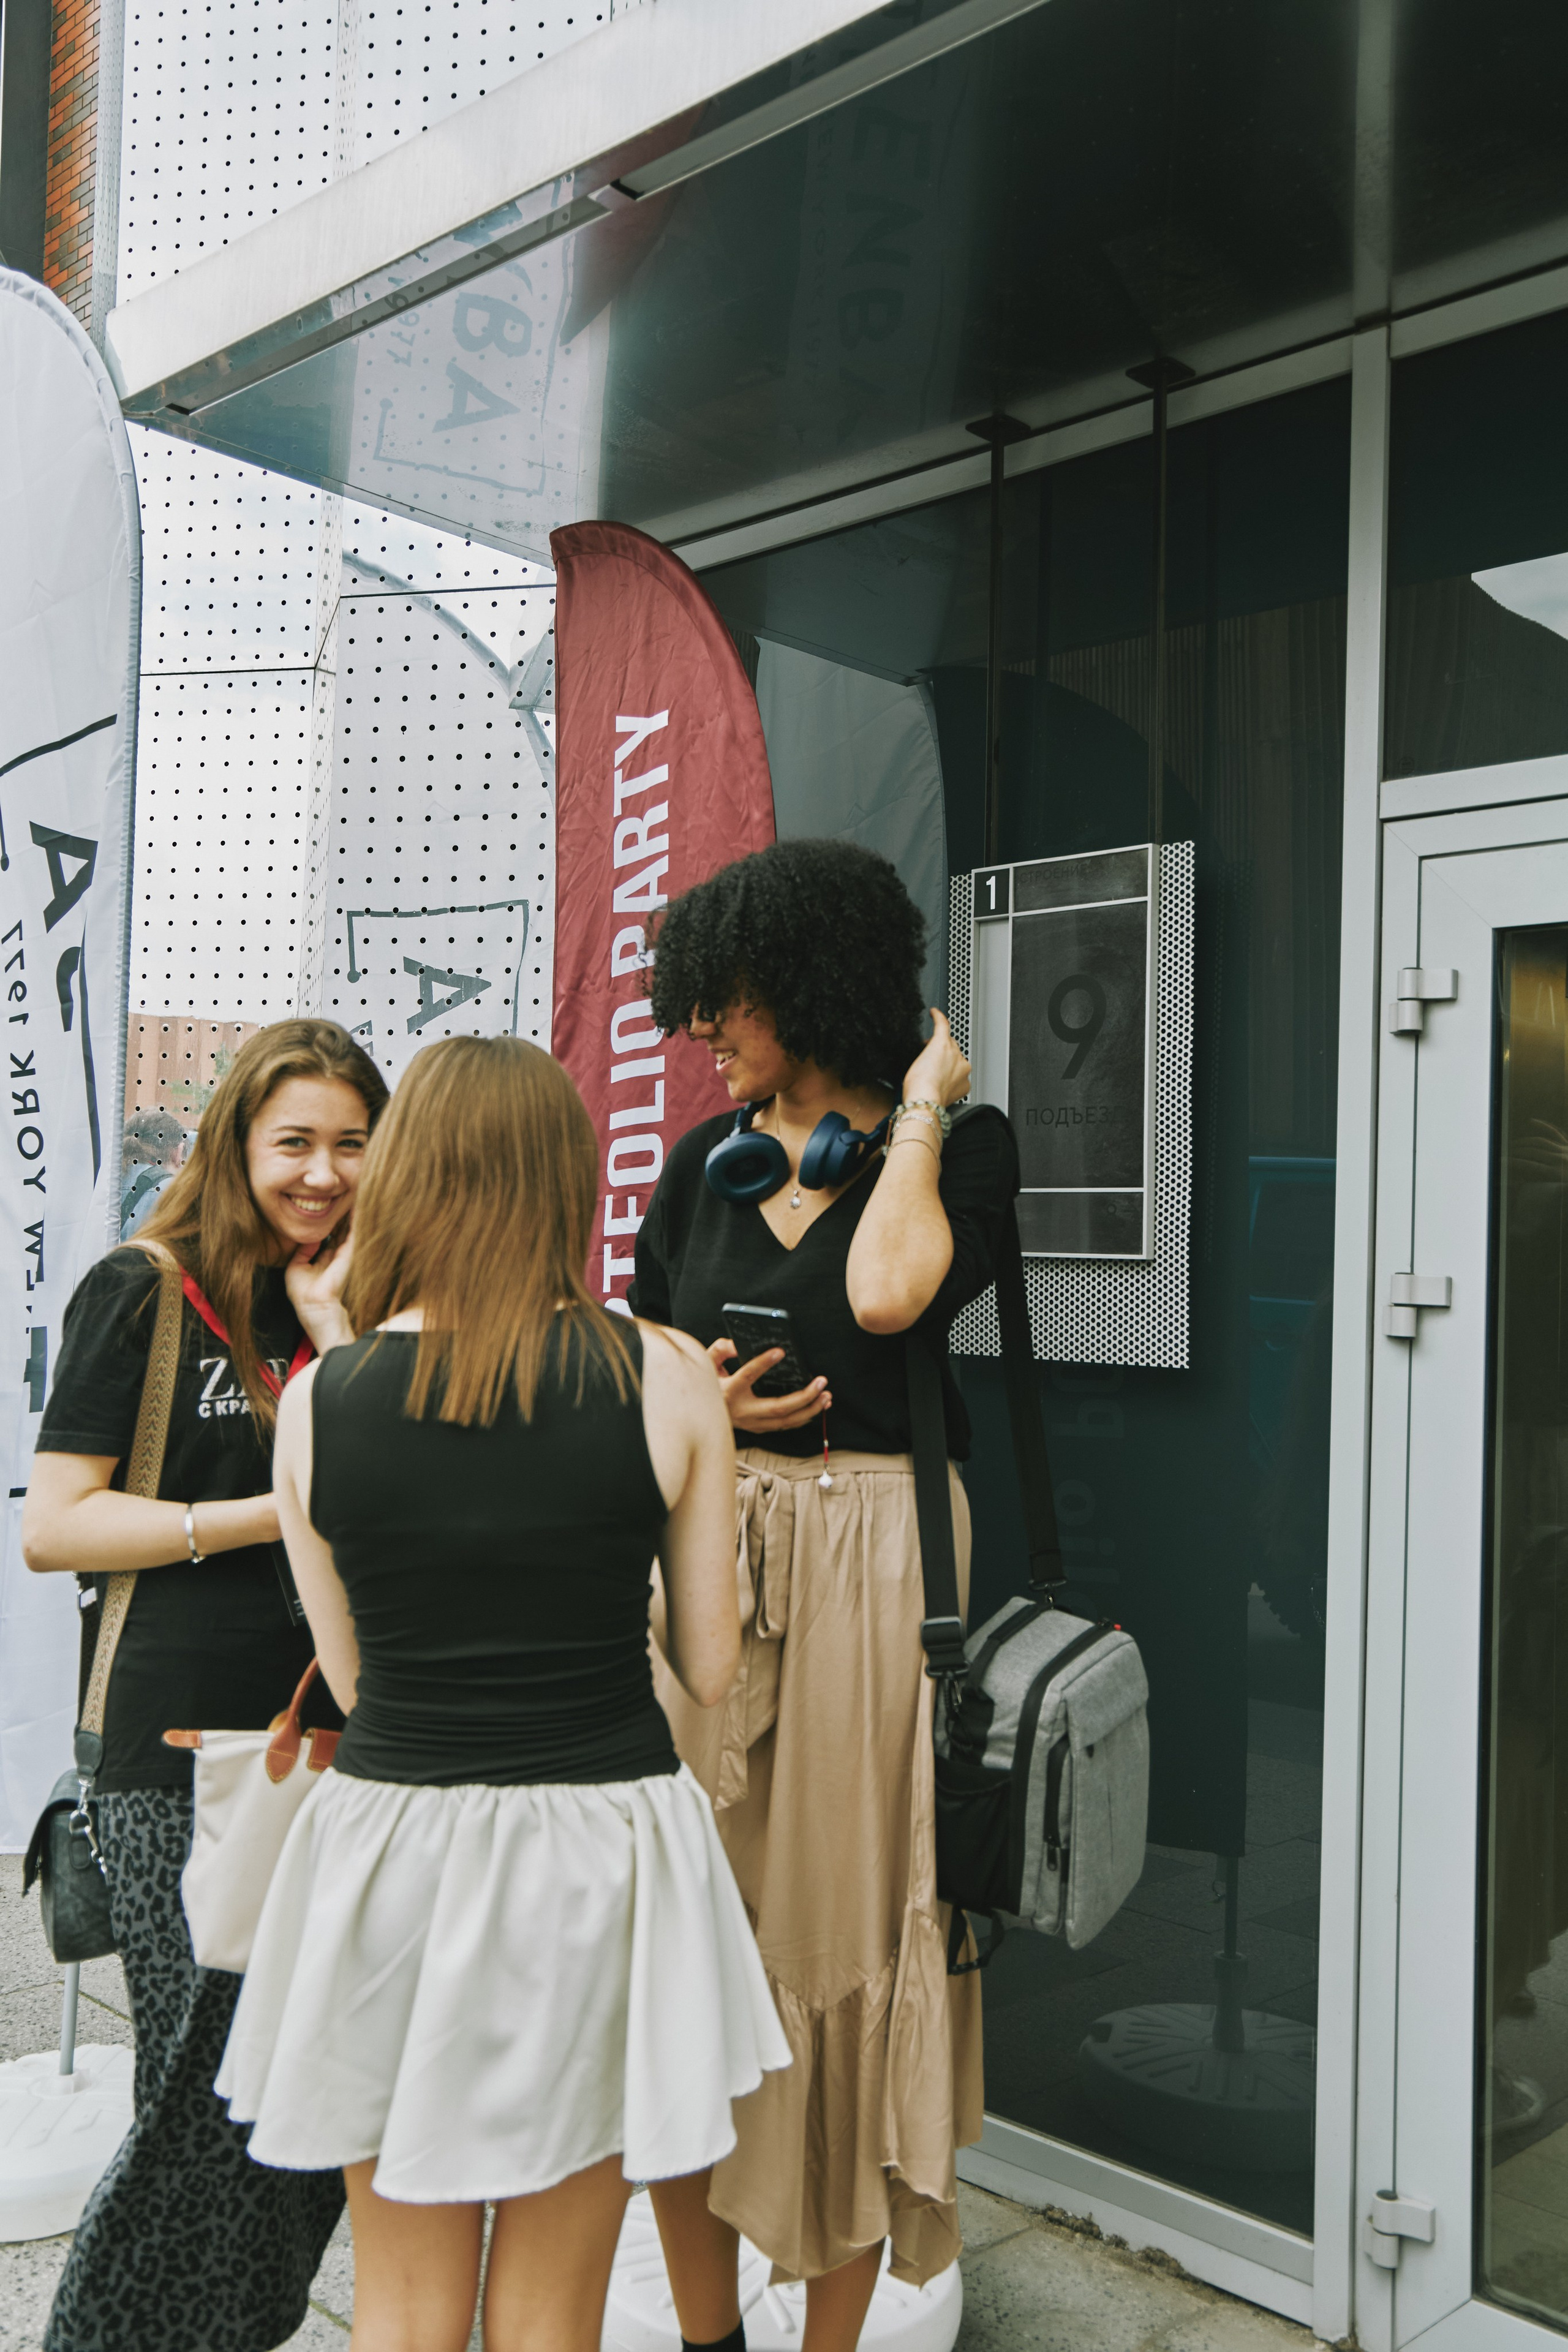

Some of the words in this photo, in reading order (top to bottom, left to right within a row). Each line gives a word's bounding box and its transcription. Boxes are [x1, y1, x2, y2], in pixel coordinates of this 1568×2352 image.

[611, 710, 668, 978] PARTY
[985, 875, 997, 910] 1
[1047, 974, 1107, 1080] 9
